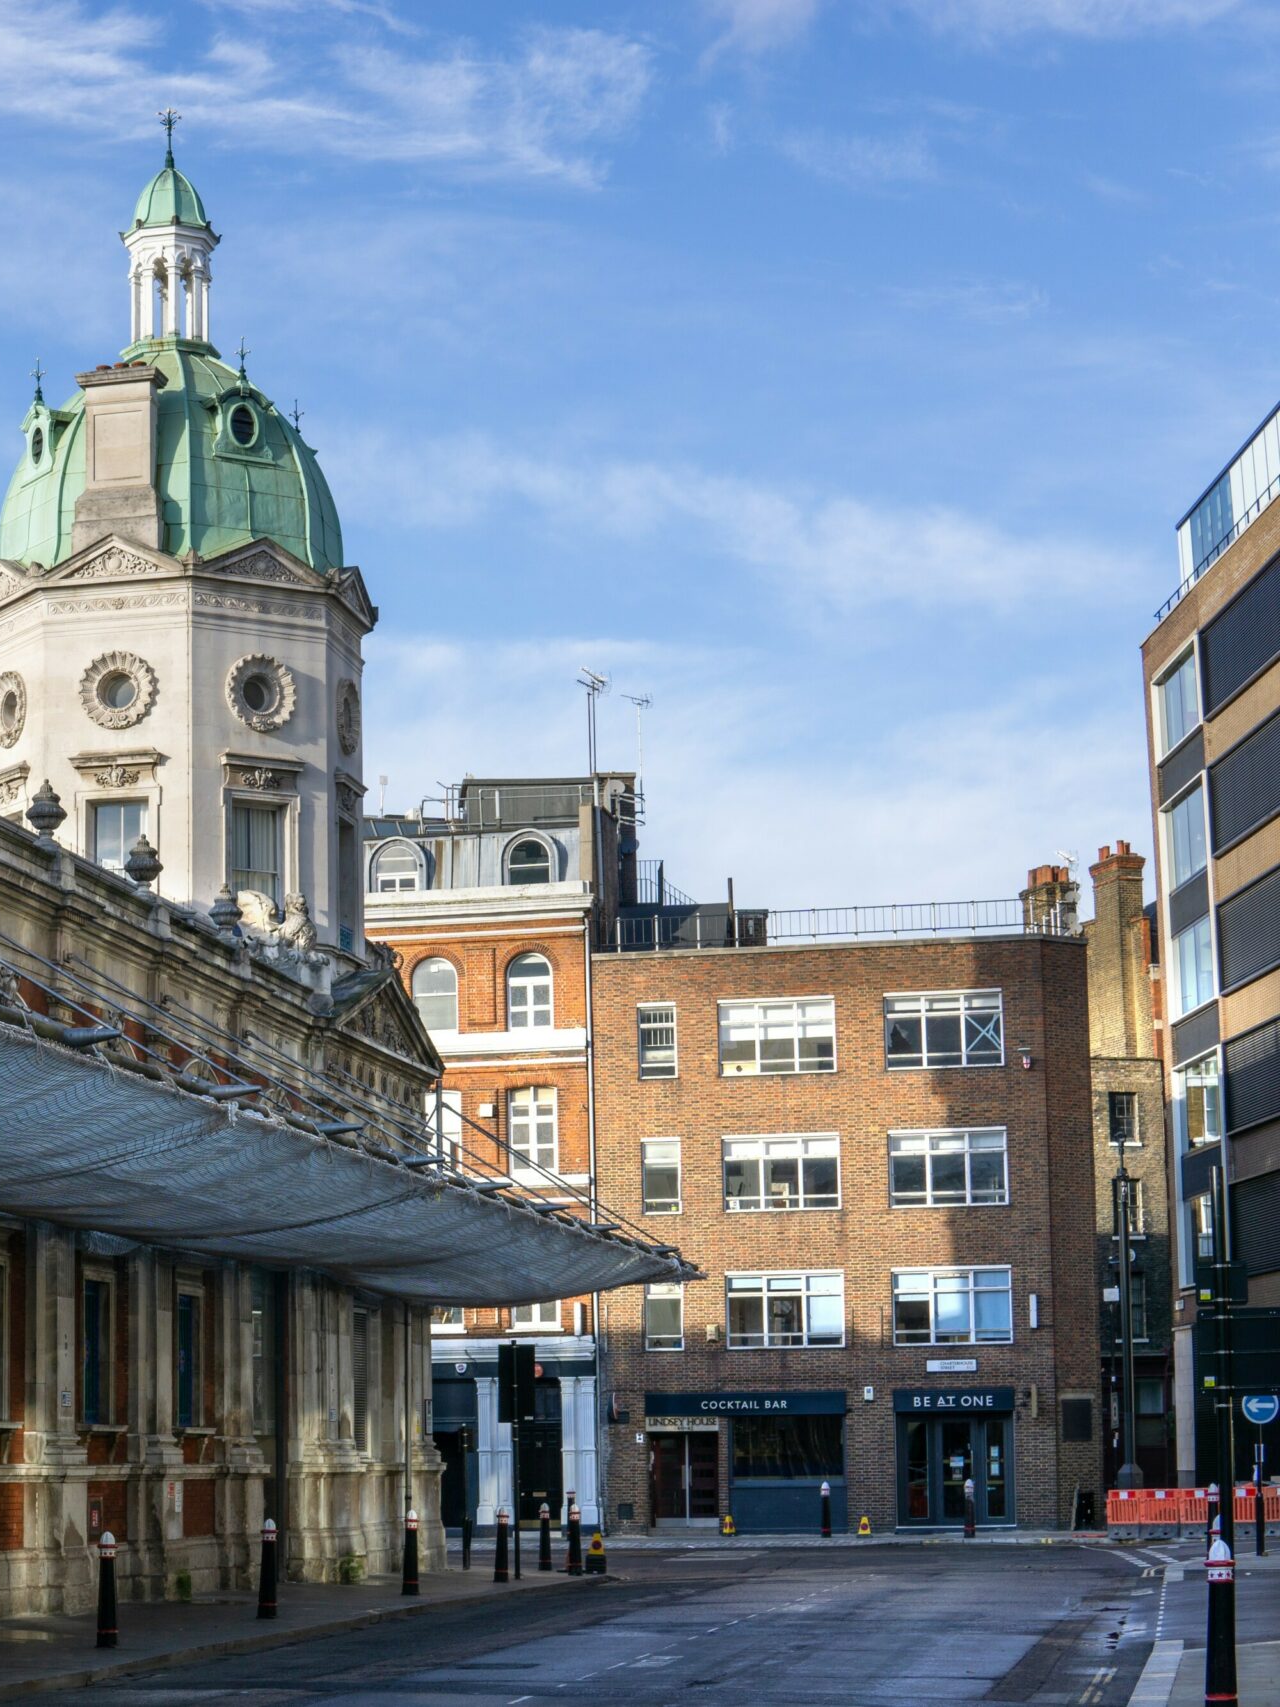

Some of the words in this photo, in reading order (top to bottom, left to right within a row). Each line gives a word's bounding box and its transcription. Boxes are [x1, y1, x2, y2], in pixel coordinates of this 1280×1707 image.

[700, 1400, 760, 1410] COCKTAIL
[764, 1400, 788, 1409] BAR
[913, 1396, 931, 1407] BE
[936, 1396, 956, 1407] AT
[960, 1396, 994, 1407] ONE
[648, 1417, 683, 1426] LINDSEY
[687, 1417, 718, 1426] HOUSE
